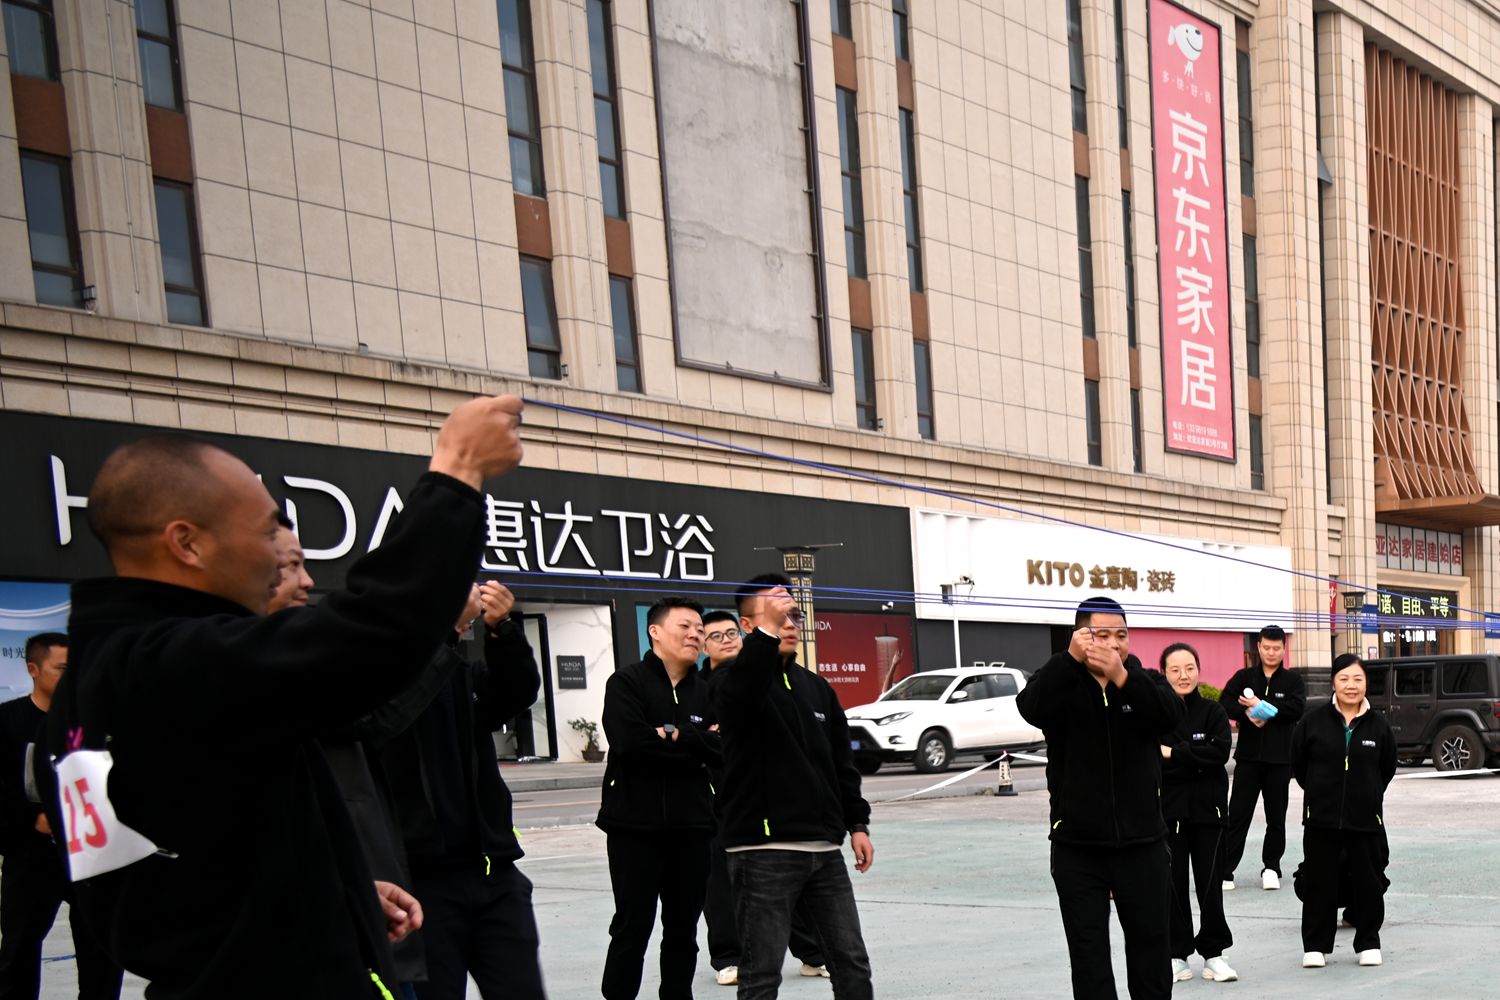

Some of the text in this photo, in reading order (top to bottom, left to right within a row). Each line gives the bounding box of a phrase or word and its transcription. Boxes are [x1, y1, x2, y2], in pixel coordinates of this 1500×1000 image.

[1169, 108, 1217, 412] 京东家居
[50, 454, 404, 560] HDA
[482, 493, 718, 582] 惠达卫浴
[1027, 559, 1085, 588] KITO
[1376, 535, 1462, 565] 亚达家居建始店
[64, 777, 108, 855] 15
